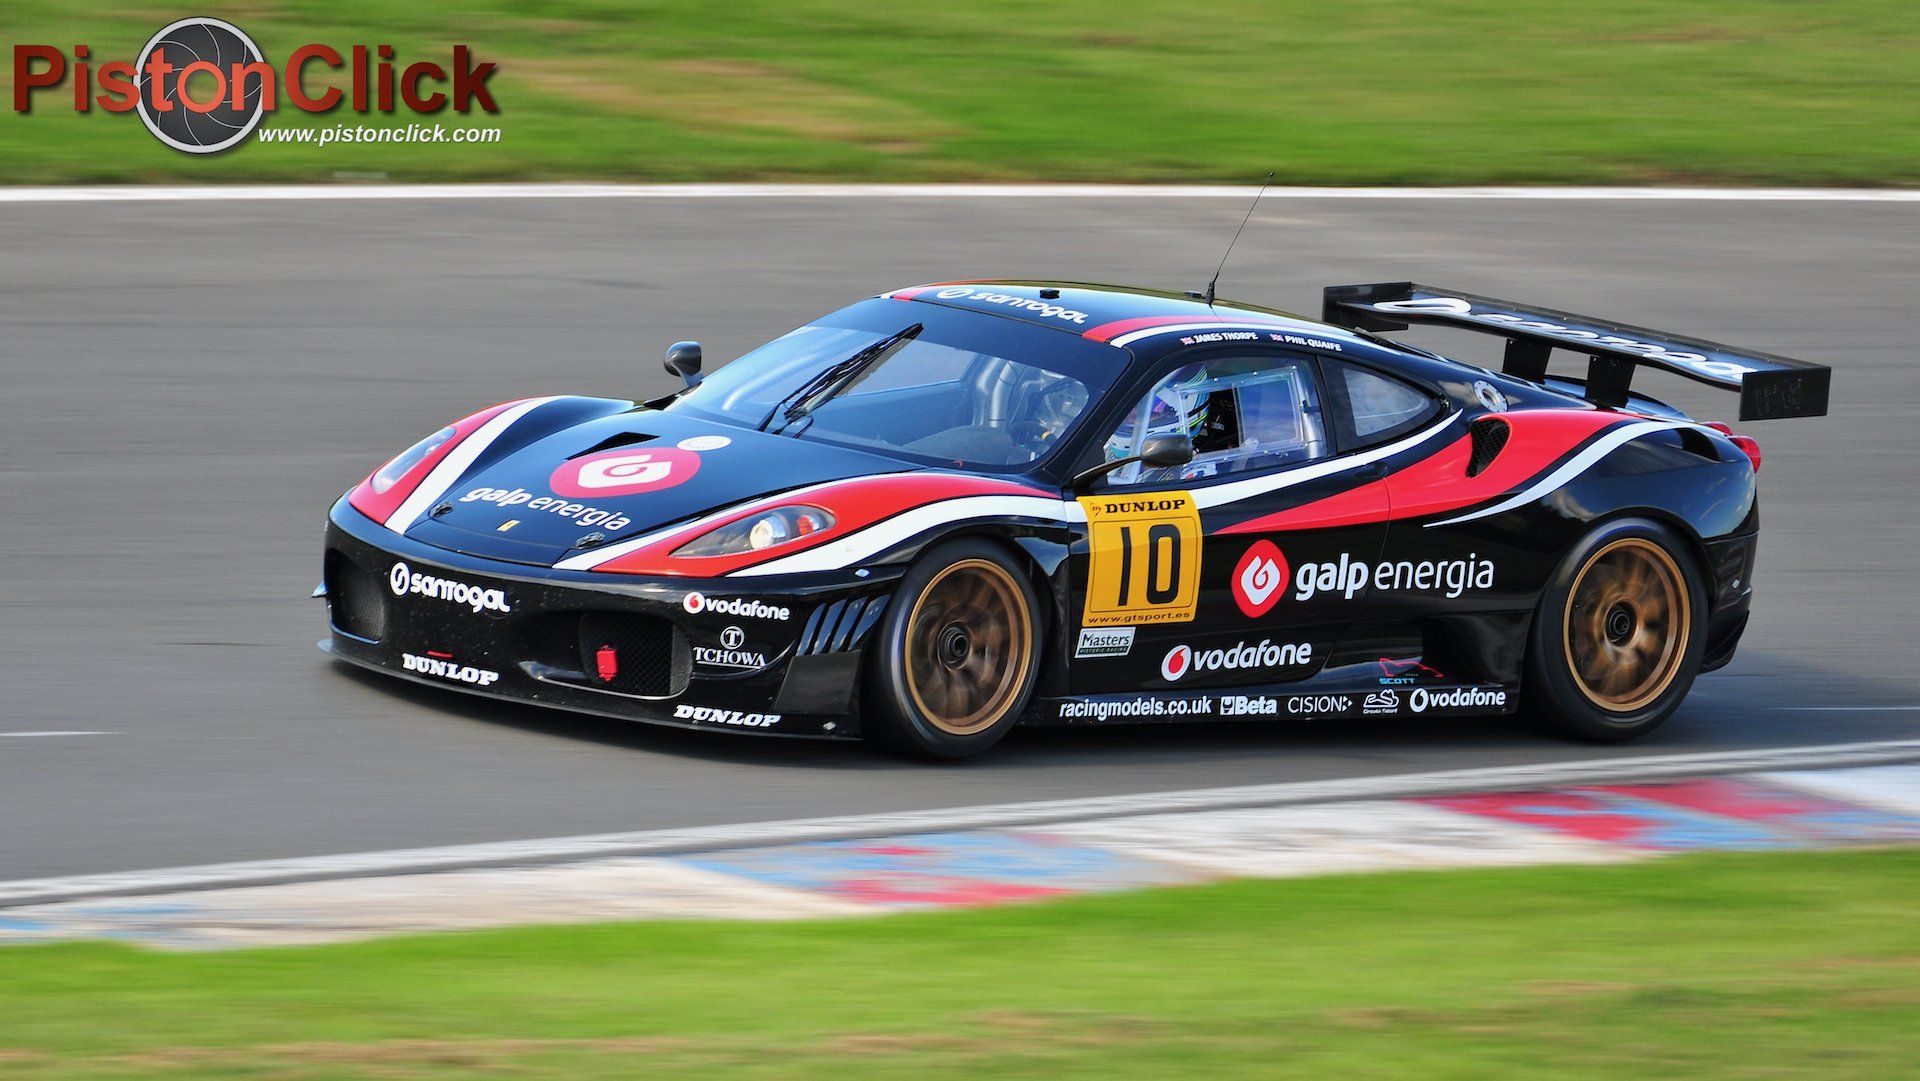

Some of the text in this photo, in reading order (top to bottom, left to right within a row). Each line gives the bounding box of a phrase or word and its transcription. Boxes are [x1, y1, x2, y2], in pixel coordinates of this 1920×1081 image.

[1193, 331, 1259, 343] JAMES THORPE
[1285, 335, 1343, 352] PHIL QUAIFE
[459, 487, 631, 531] galp energia
[1105, 500, 1186, 514] DUNLOP
[1117, 523, 1182, 607] 10
[1295, 553, 1495, 601] galp energia
[705, 598, 791, 621] vodafone
[1088, 612, 1190, 624] www.gtsport.es
[1081, 633, 1131, 647] Masters
[692, 646, 767, 667] TCHOWA
[1194, 639, 1312, 671] vodafone
[402, 652, 500, 688] DUNLOP
[1378, 677, 1416, 685] SCOTT
[1235, 696, 1278, 715] Beta
[1288, 696, 1343, 713] CISION
[1428, 687, 1506, 707] vodafone
[674, 704, 782, 728] DUNLOP
[1059, 696, 1212, 721] racingmodels.co.uk
